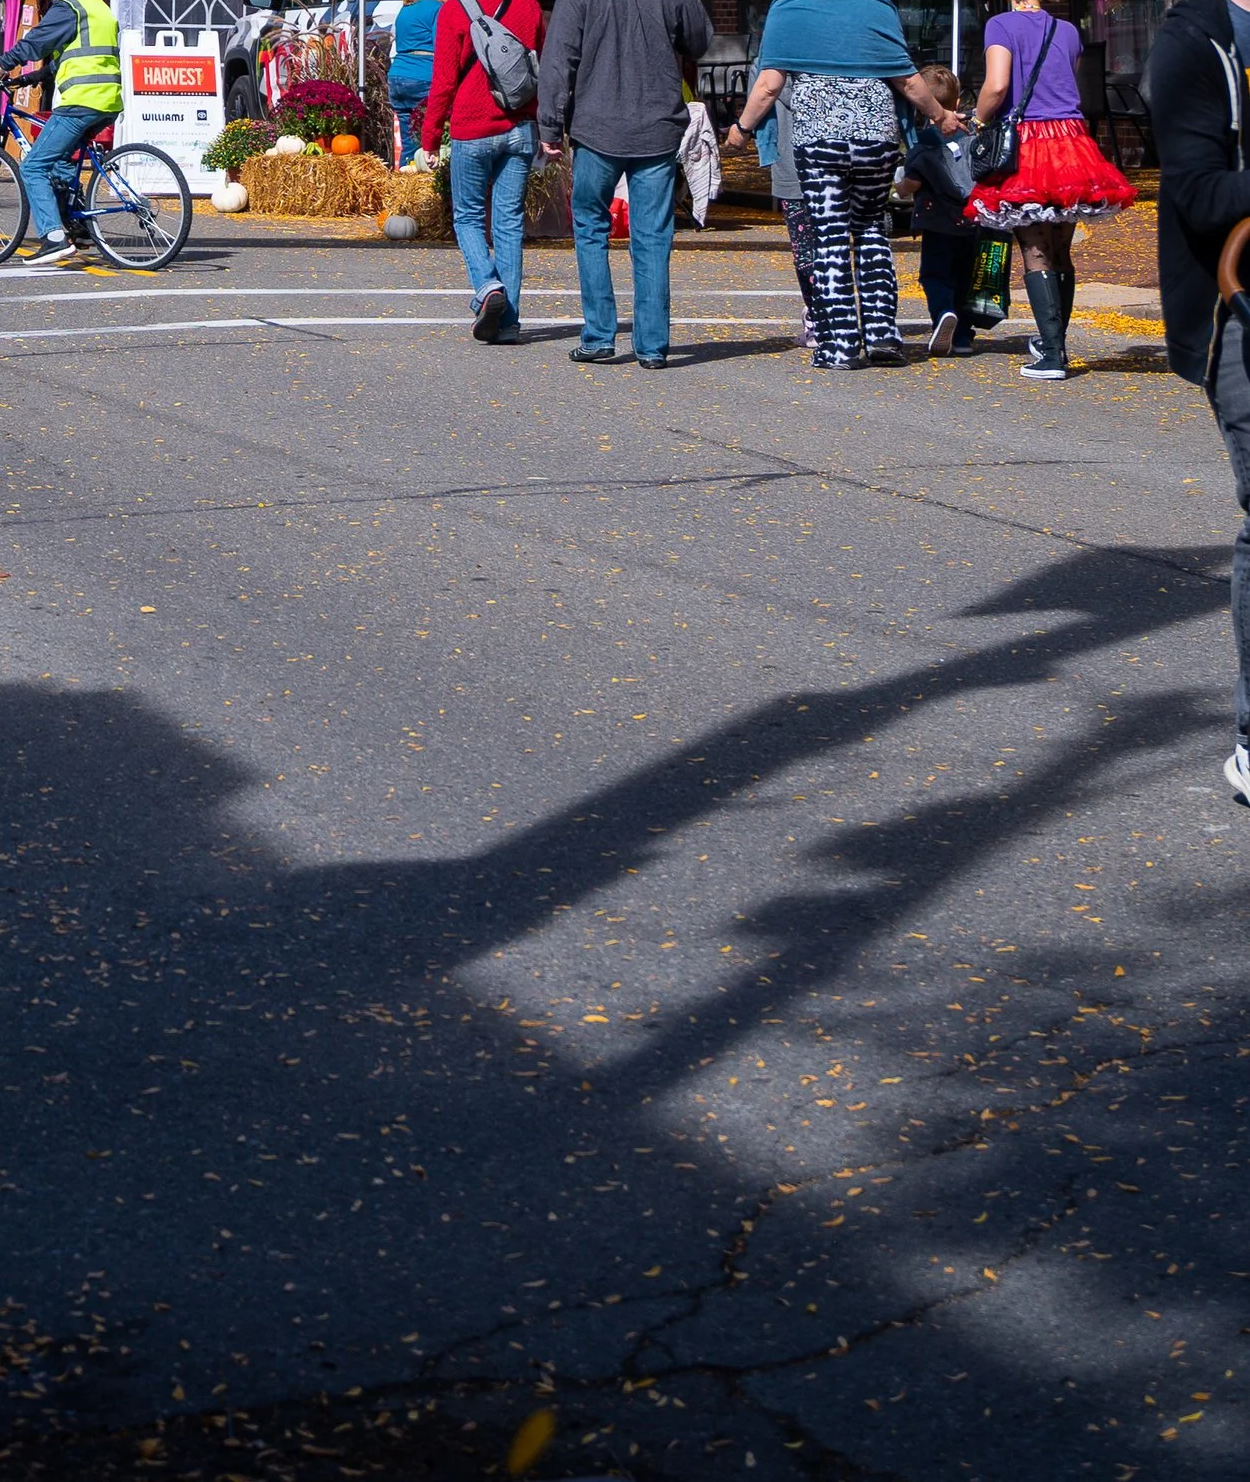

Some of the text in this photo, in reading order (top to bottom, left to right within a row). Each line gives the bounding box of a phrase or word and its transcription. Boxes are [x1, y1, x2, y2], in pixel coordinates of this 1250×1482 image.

[143, 66, 203, 86] HARVEST
[142, 113, 184, 122] WILLIAMS
[973, 252, 988, 290] Reduce
